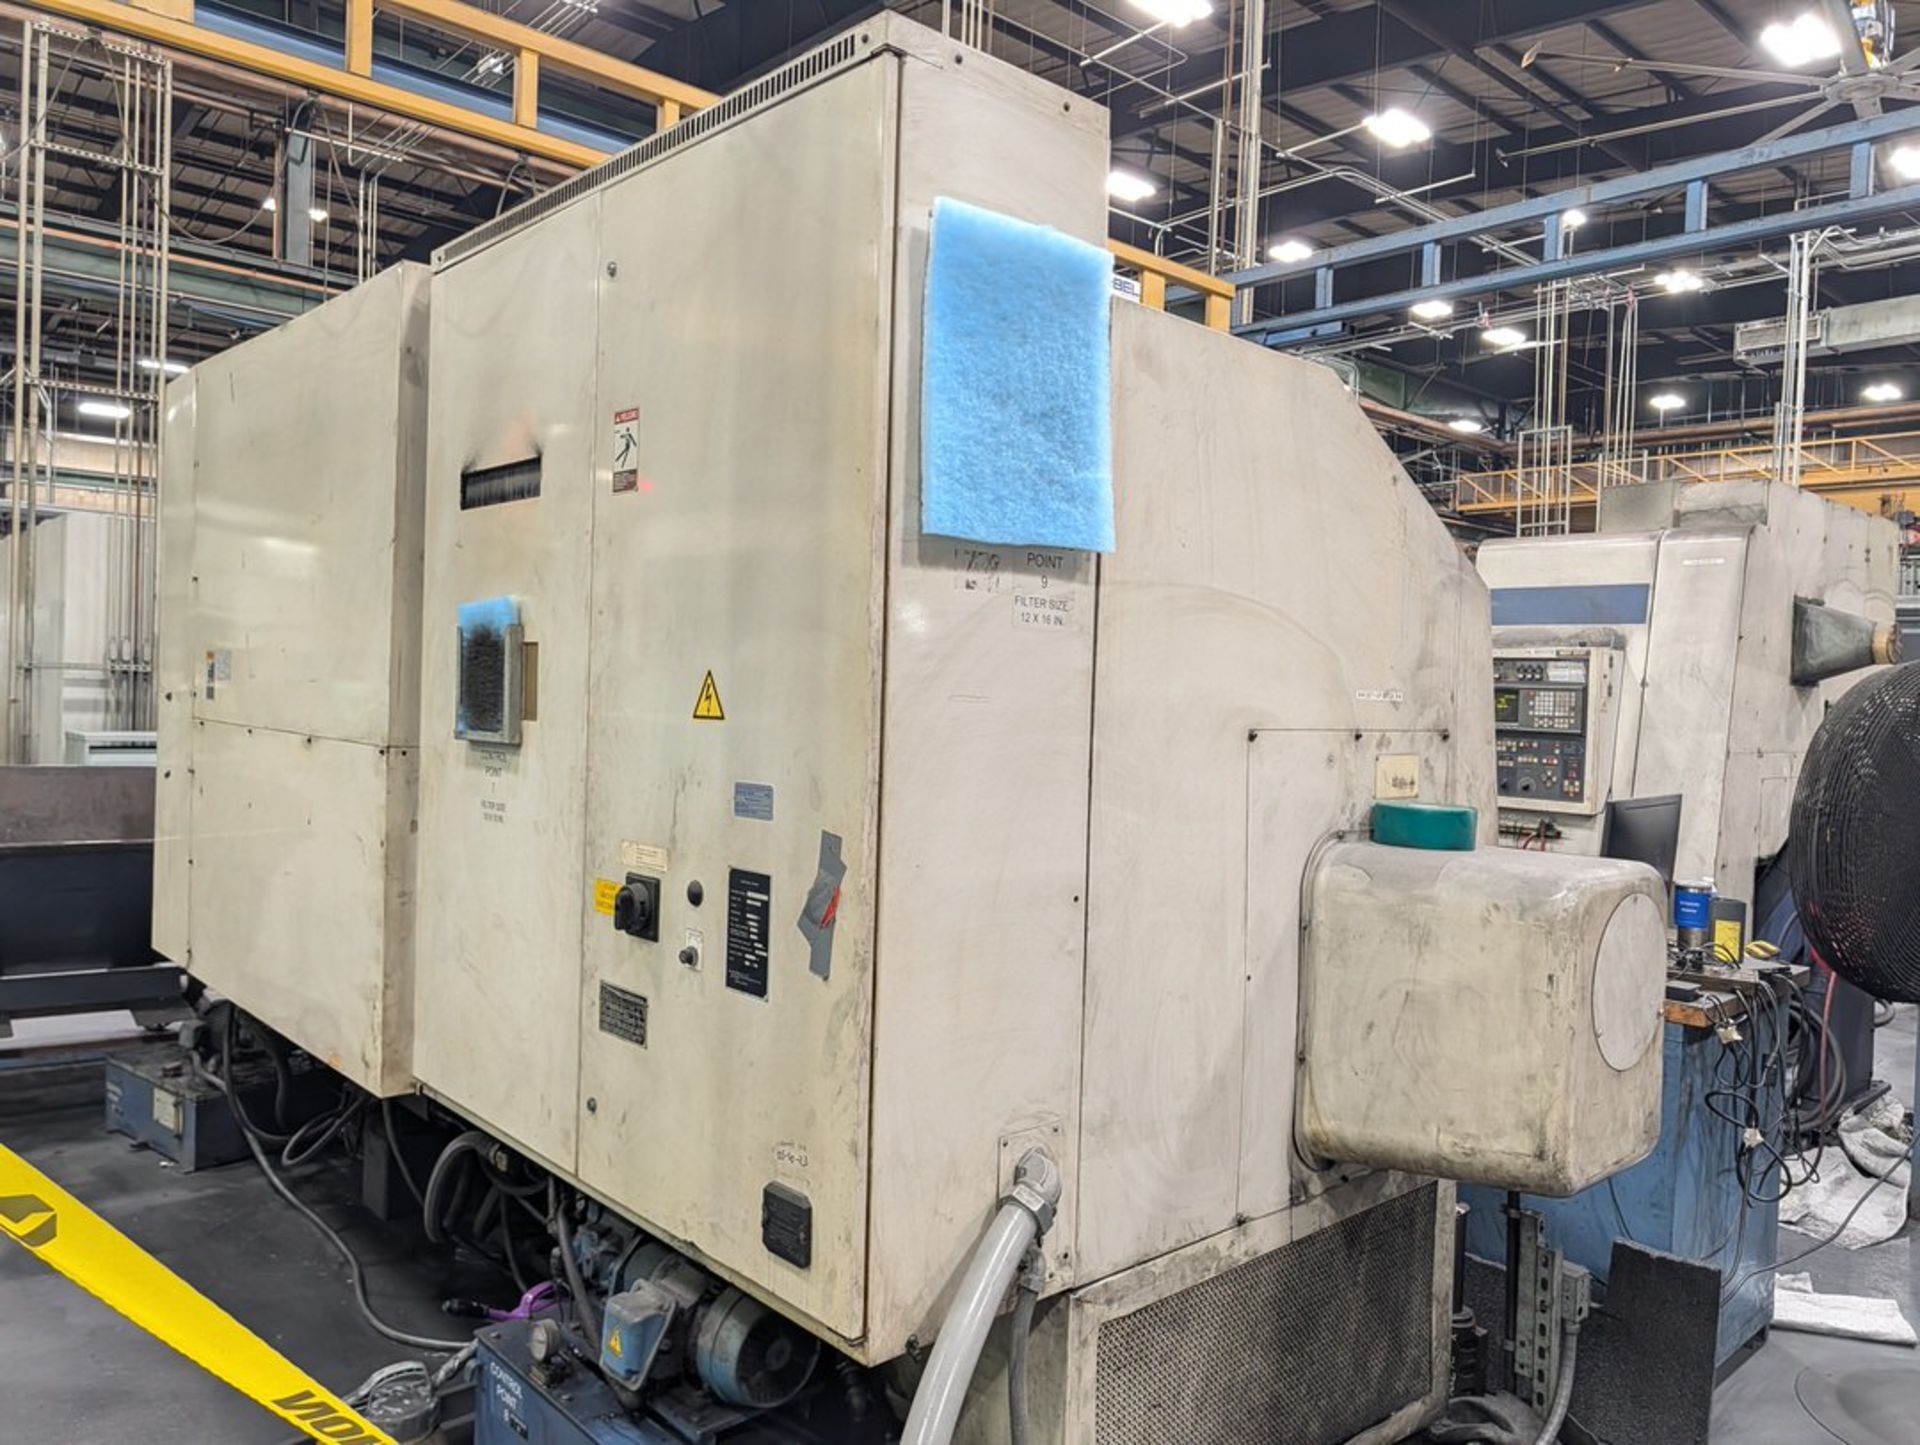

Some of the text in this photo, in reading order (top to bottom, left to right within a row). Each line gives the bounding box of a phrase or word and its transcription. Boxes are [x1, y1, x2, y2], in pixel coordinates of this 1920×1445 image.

[1026, 551, 1063, 569] POINT
[1041, 575, 1048, 589] 9
[1014, 595, 1070, 612] FILTER SIZE
[1021, 612, 1031, 623] 12
[1033, 613, 1039, 623] X
[490, 1362, 523, 1399] CONTROL
[496, 1384, 517, 1410] POINT
